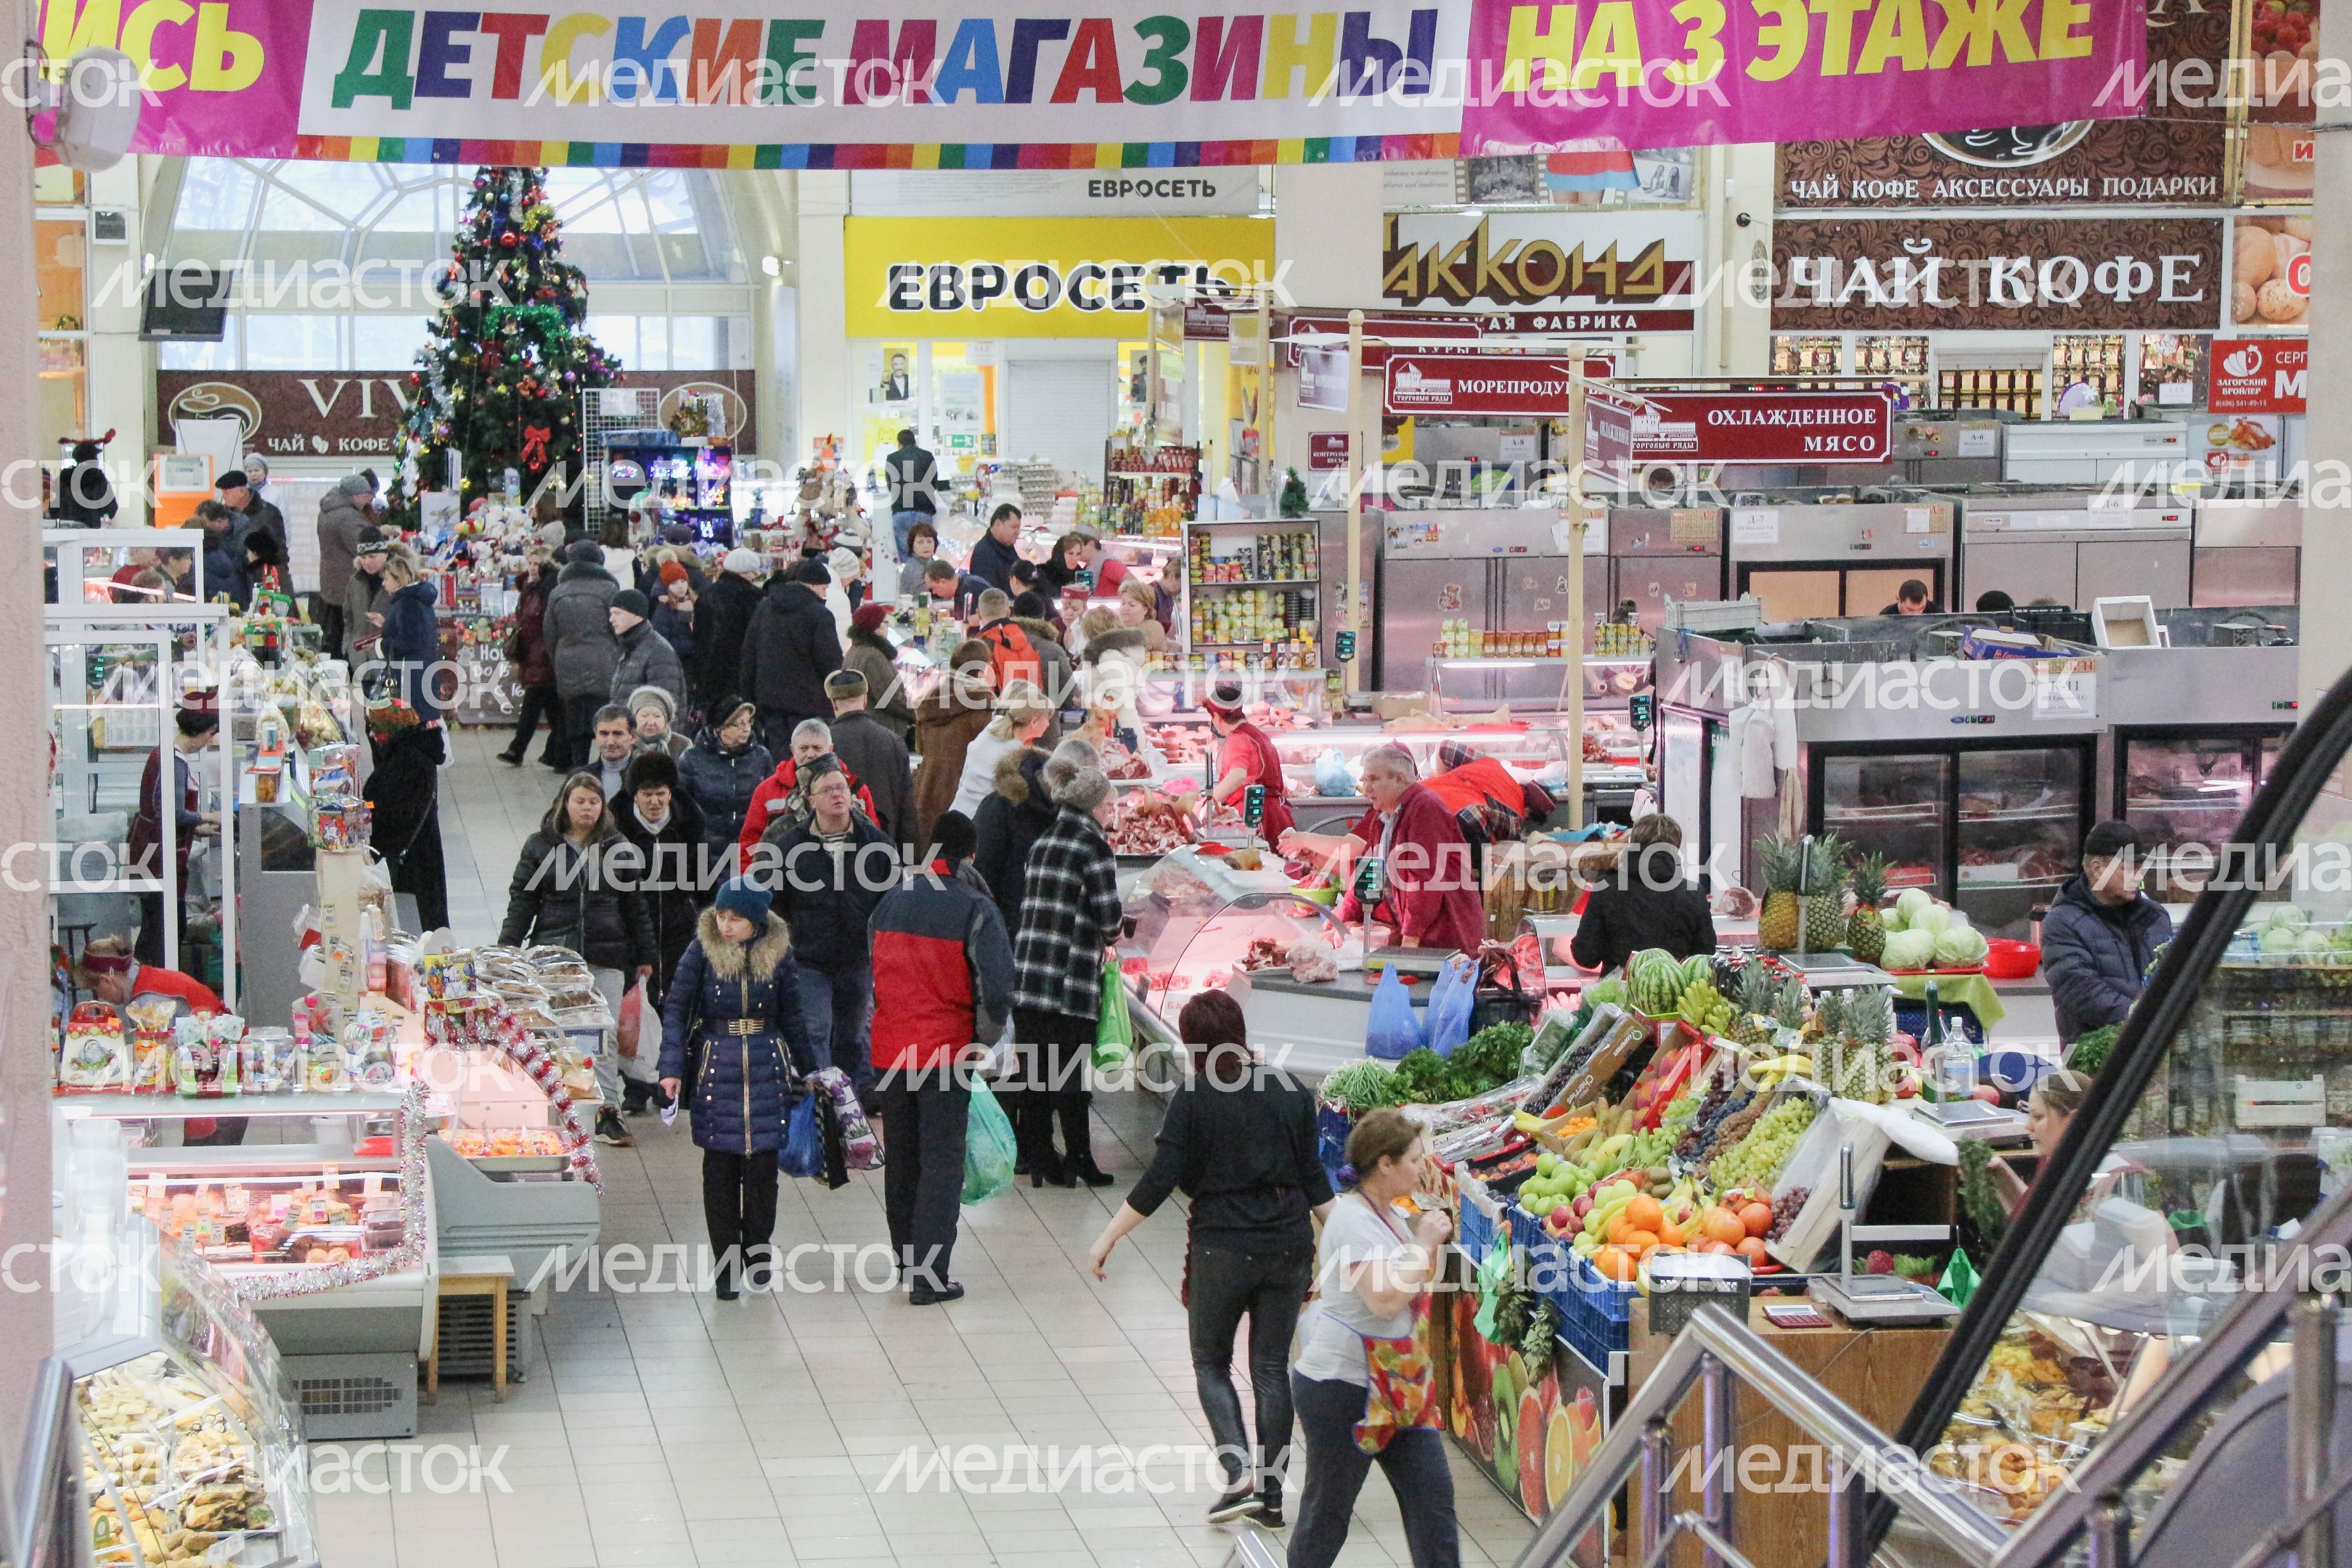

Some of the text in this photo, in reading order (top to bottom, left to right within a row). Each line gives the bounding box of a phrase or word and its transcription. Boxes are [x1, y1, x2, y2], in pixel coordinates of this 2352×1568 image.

[1502, 0, 2095, 93] НА 3 ЭТАЖЕ
[331, 9, 1437, 110] ДЕТСКИЕ МАГАЗИНЫ
[1089, 179, 1217, 198] ЕВРОСЕТЬ
[1791, 174, 2216, 200] ЧАЙ КОФЕ АКСЕССУАРЫ ПОДАРКИ
[1792, 238, 2204, 303] ЧАЙ КОФЕ
[1532, 314, 1638, 330] ФАБРИКА
[2222, 387, 2261, 396] БРОЙЛЕР
[1708, 409, 1876, 428] ОХЛАЖДЕННОЕ
[268, 434, 390, 452] ЧАЙ КОФЕ
[1804, 436, 1876, 452] МЯСО
[1567, 1074, 1593, 1104] Cherries
